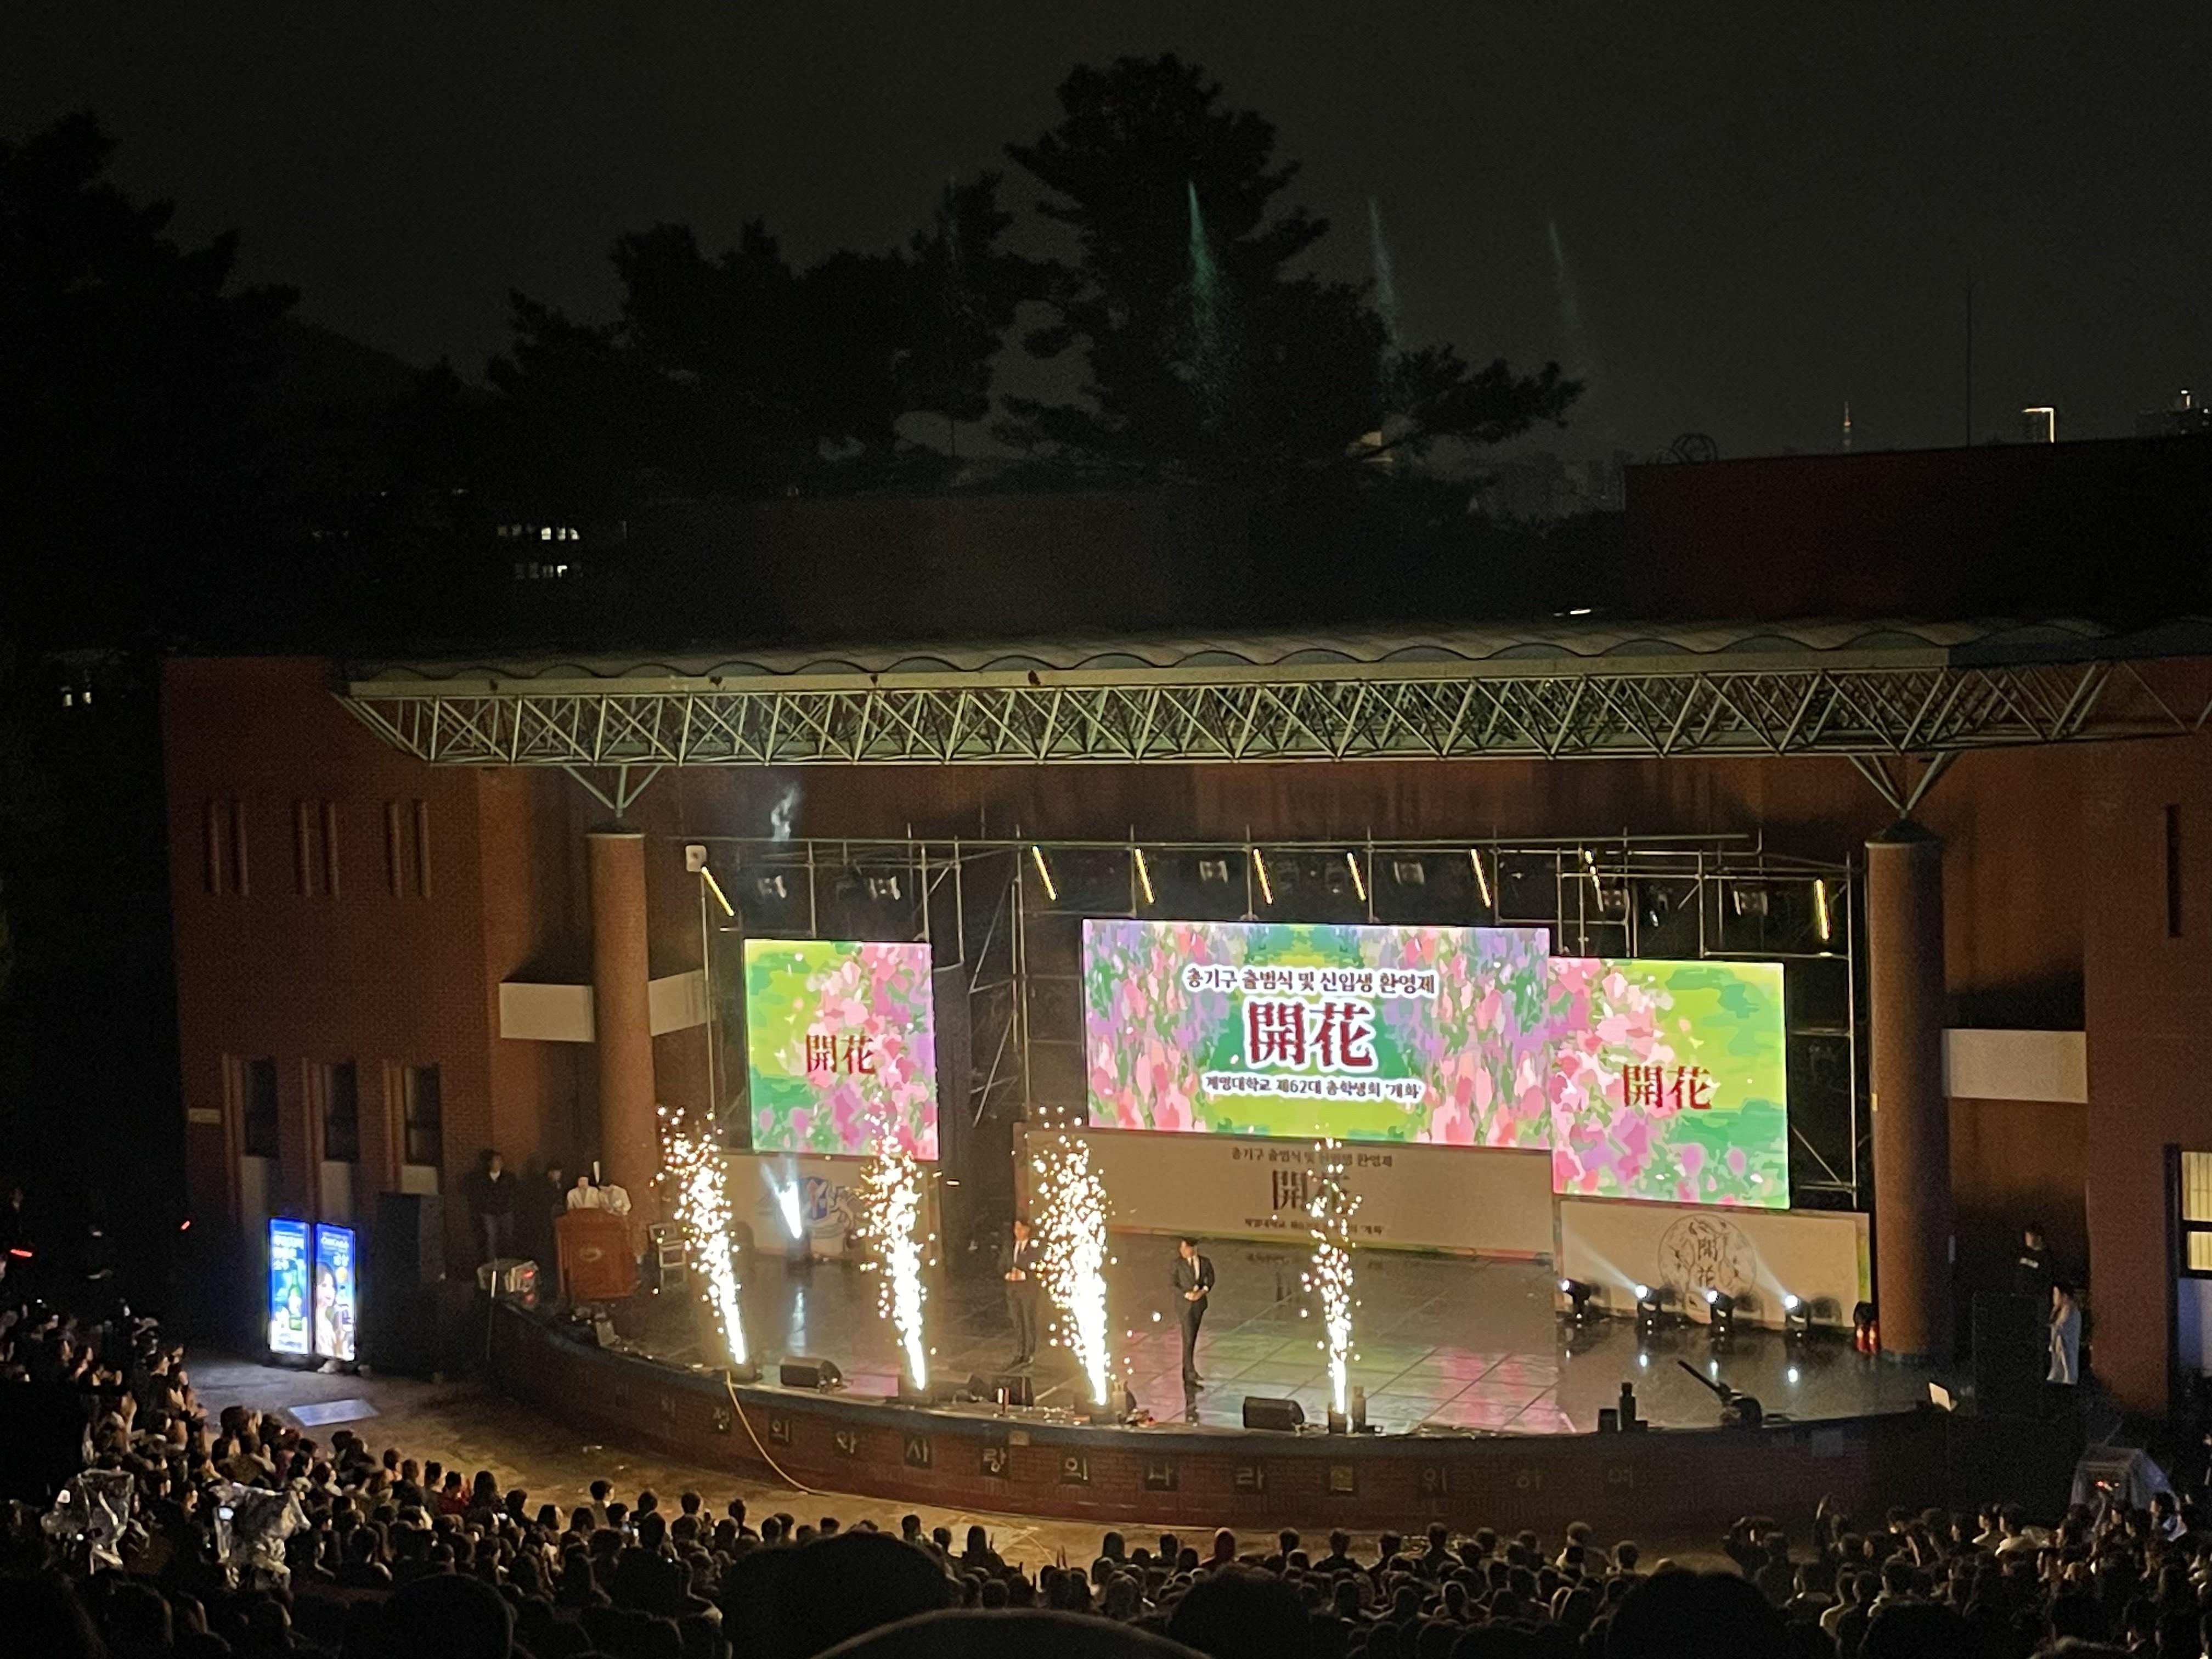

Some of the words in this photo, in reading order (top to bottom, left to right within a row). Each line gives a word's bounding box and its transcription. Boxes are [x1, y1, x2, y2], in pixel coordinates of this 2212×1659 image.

[1187, 968, 1237, 988] 총기구
[1242, 969, 1293, 990] 출범식
[1299, 972, 1315, 992] 및
[1320, 972, 1373, 993] 신입생
[1379, 973, 1436, 995] 환영제
[805, 1033, 877, 1075] 開花
[1248, 1001, 1373, 1068] 開花
[1276, 1078, 1322, 1095] 제62대
[1326, 1080, 1381, 1097] 총학생회
[1621, 1064, 1713, 1110] 開花
